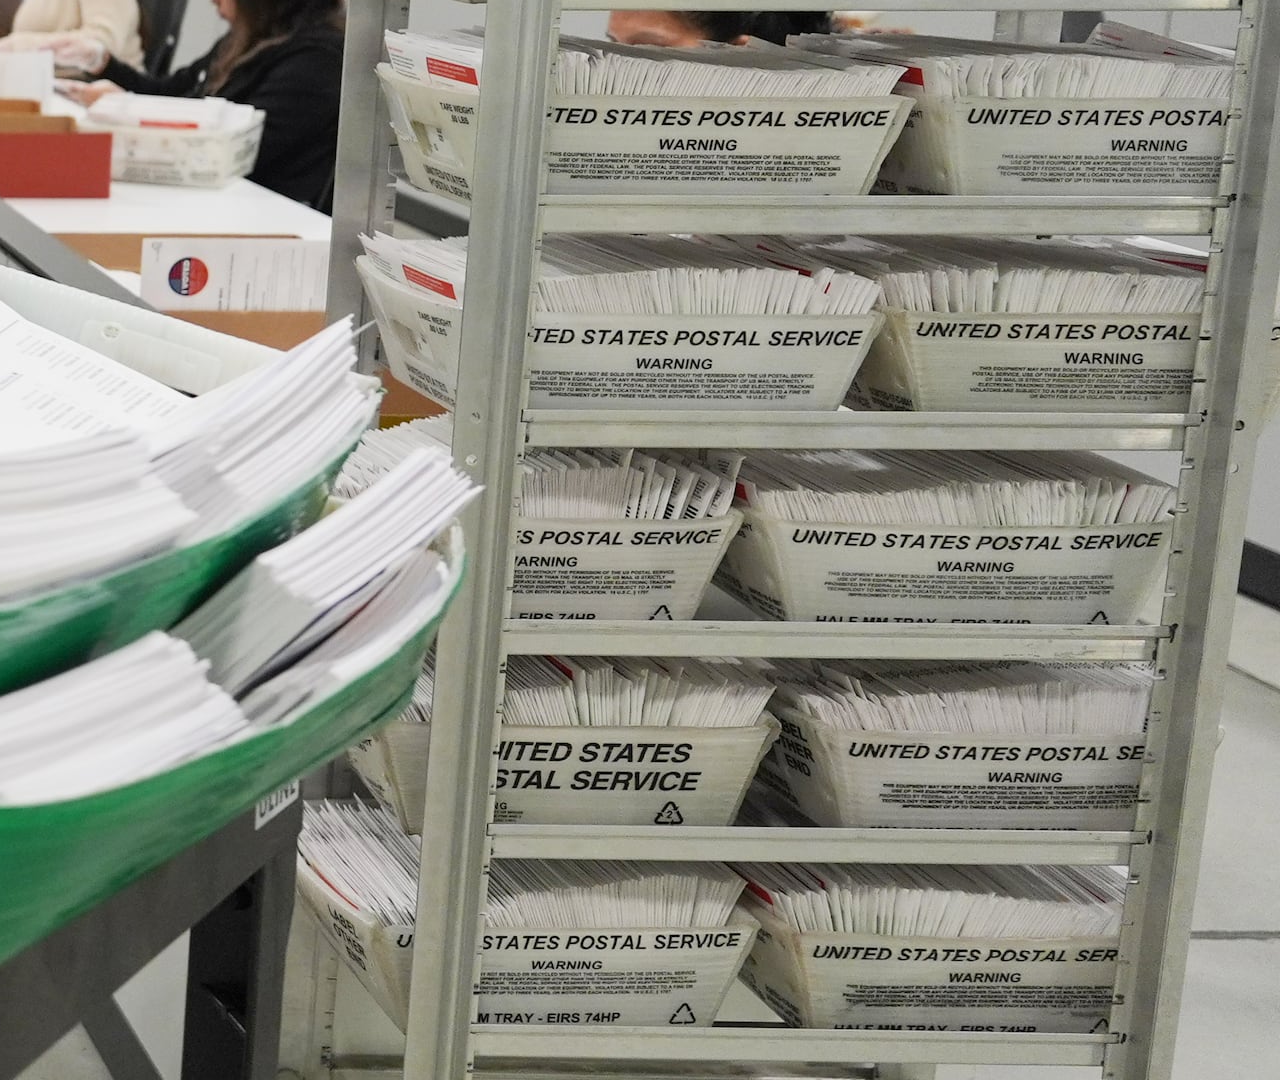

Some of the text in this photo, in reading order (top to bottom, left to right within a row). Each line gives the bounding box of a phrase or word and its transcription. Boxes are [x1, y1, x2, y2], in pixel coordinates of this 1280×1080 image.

[604, 110, 692, 126] STATES
[698, 111, 786, 126] POSTAL
[795, 110, 890, 126] SERVICE
[968, 109, 1231, 126] UNITED STATES POSTA
[660, 139, 737, 150] WARNING
[1112, 140, 1187, 151] WARNING
[582, 330, 862, 346] STATES POSTAL SERVICE
[917, 322, 1191, 340] UNITED STATES POSTAL
[636, 358, 712, 369] WARNING
[1065, 353, 1143, 364] WARNING
[540, 529, 721, 546] POSTAL SERVICE
[792, 529, 1162, 550] UNITED STATES POSTAL SERVICE
[938, 562, 1014, 572] WARNING
[579, 743, 692, 762] STATES
[849, 742, 930, 758] UNITED
[936, 746, 1021, 760] STATES
[1026, 747, 1108, 761] POSTAL
[571, 771, 701, 791] SERVICE
[989, 772, 1062, 782] WARNING
[483, 933, 740, 949] STATES POSTAL SERVICE
[813, 946, 892, 960] UNITED
[898, 948, 980, 961] STATES
[985, 950, 1066, 962] POSTAL
[532, 961, 602, 969] WARNING
[950, 973, 1020, 982] WARNING
[495, 1013, 620, 1023] TRAY EIRS 74HP
